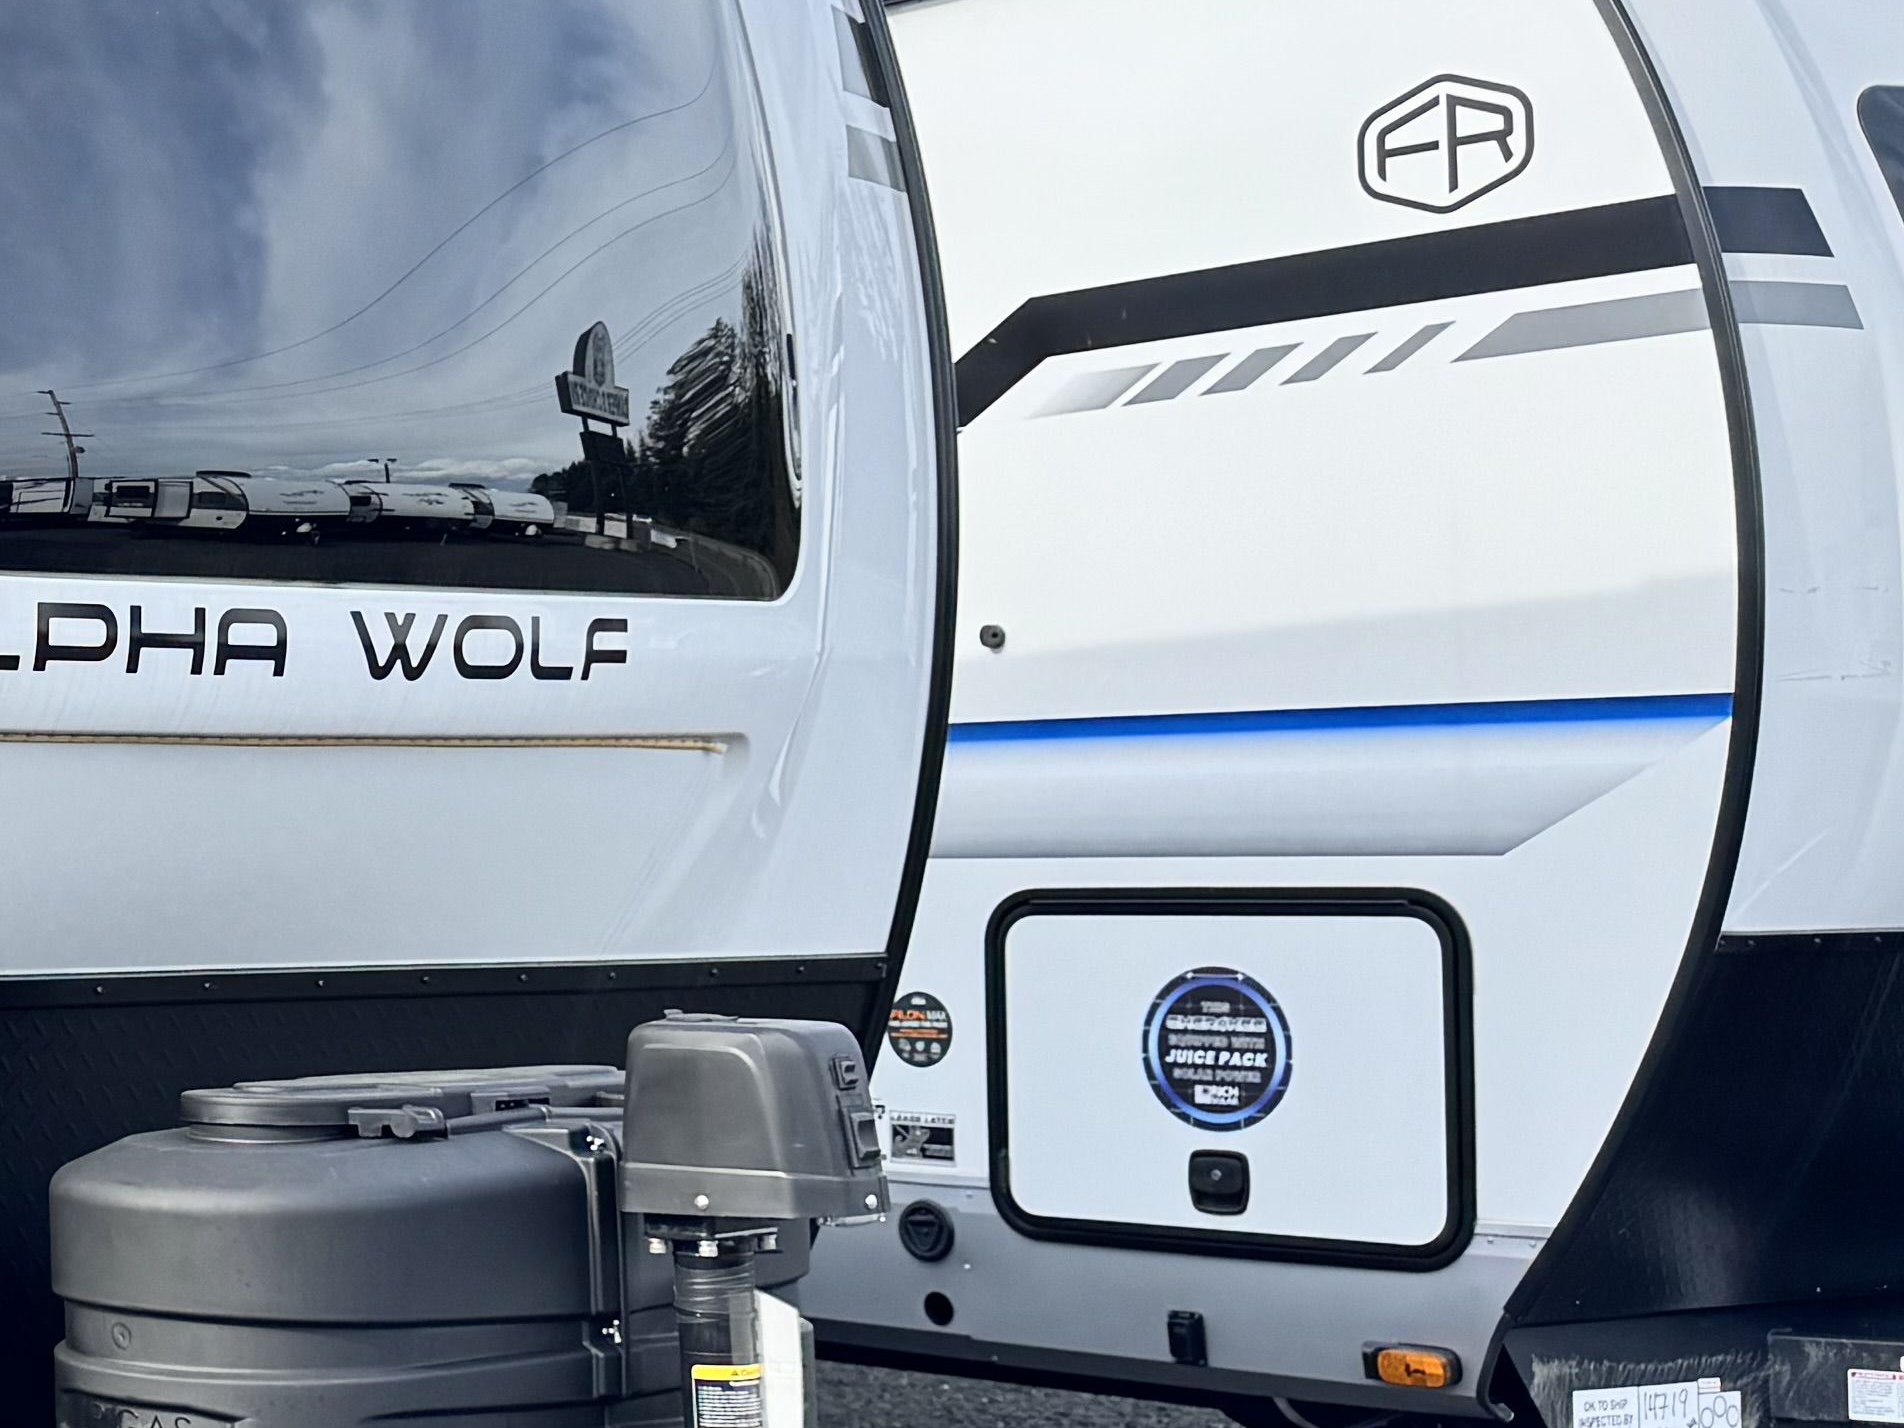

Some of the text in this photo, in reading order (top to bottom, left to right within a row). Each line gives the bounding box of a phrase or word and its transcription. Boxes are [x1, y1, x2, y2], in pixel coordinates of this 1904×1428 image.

[349, 610, 629, 682] WOLF
[1165, 1049, 1269, 1067] JUICE PACK
